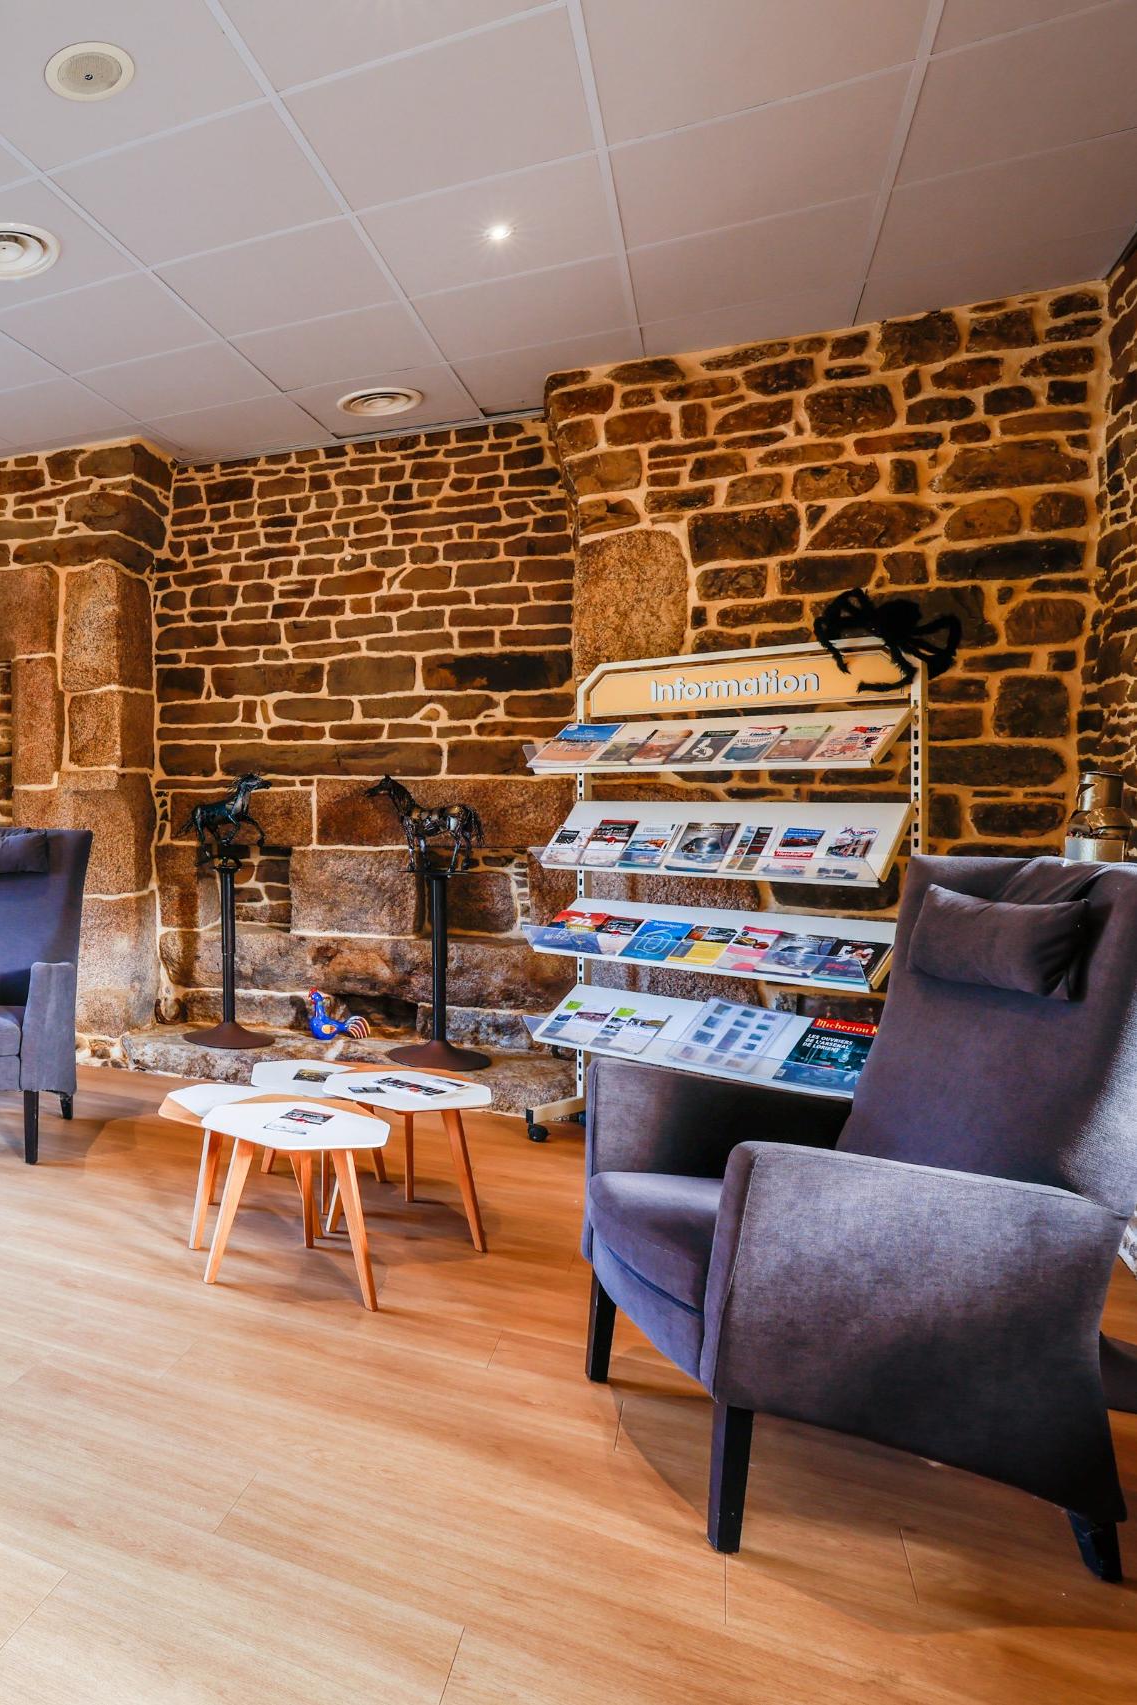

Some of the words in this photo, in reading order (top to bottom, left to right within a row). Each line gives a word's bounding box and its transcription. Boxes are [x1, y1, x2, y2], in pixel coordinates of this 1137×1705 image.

[650, 668, 820, 704] Information
[815, 1039, 850, 1050] L'ARSENAL
[821, 1036, 853, 1045] OUVRIERS
[812, 1043, 841, 1053] LORIENT
